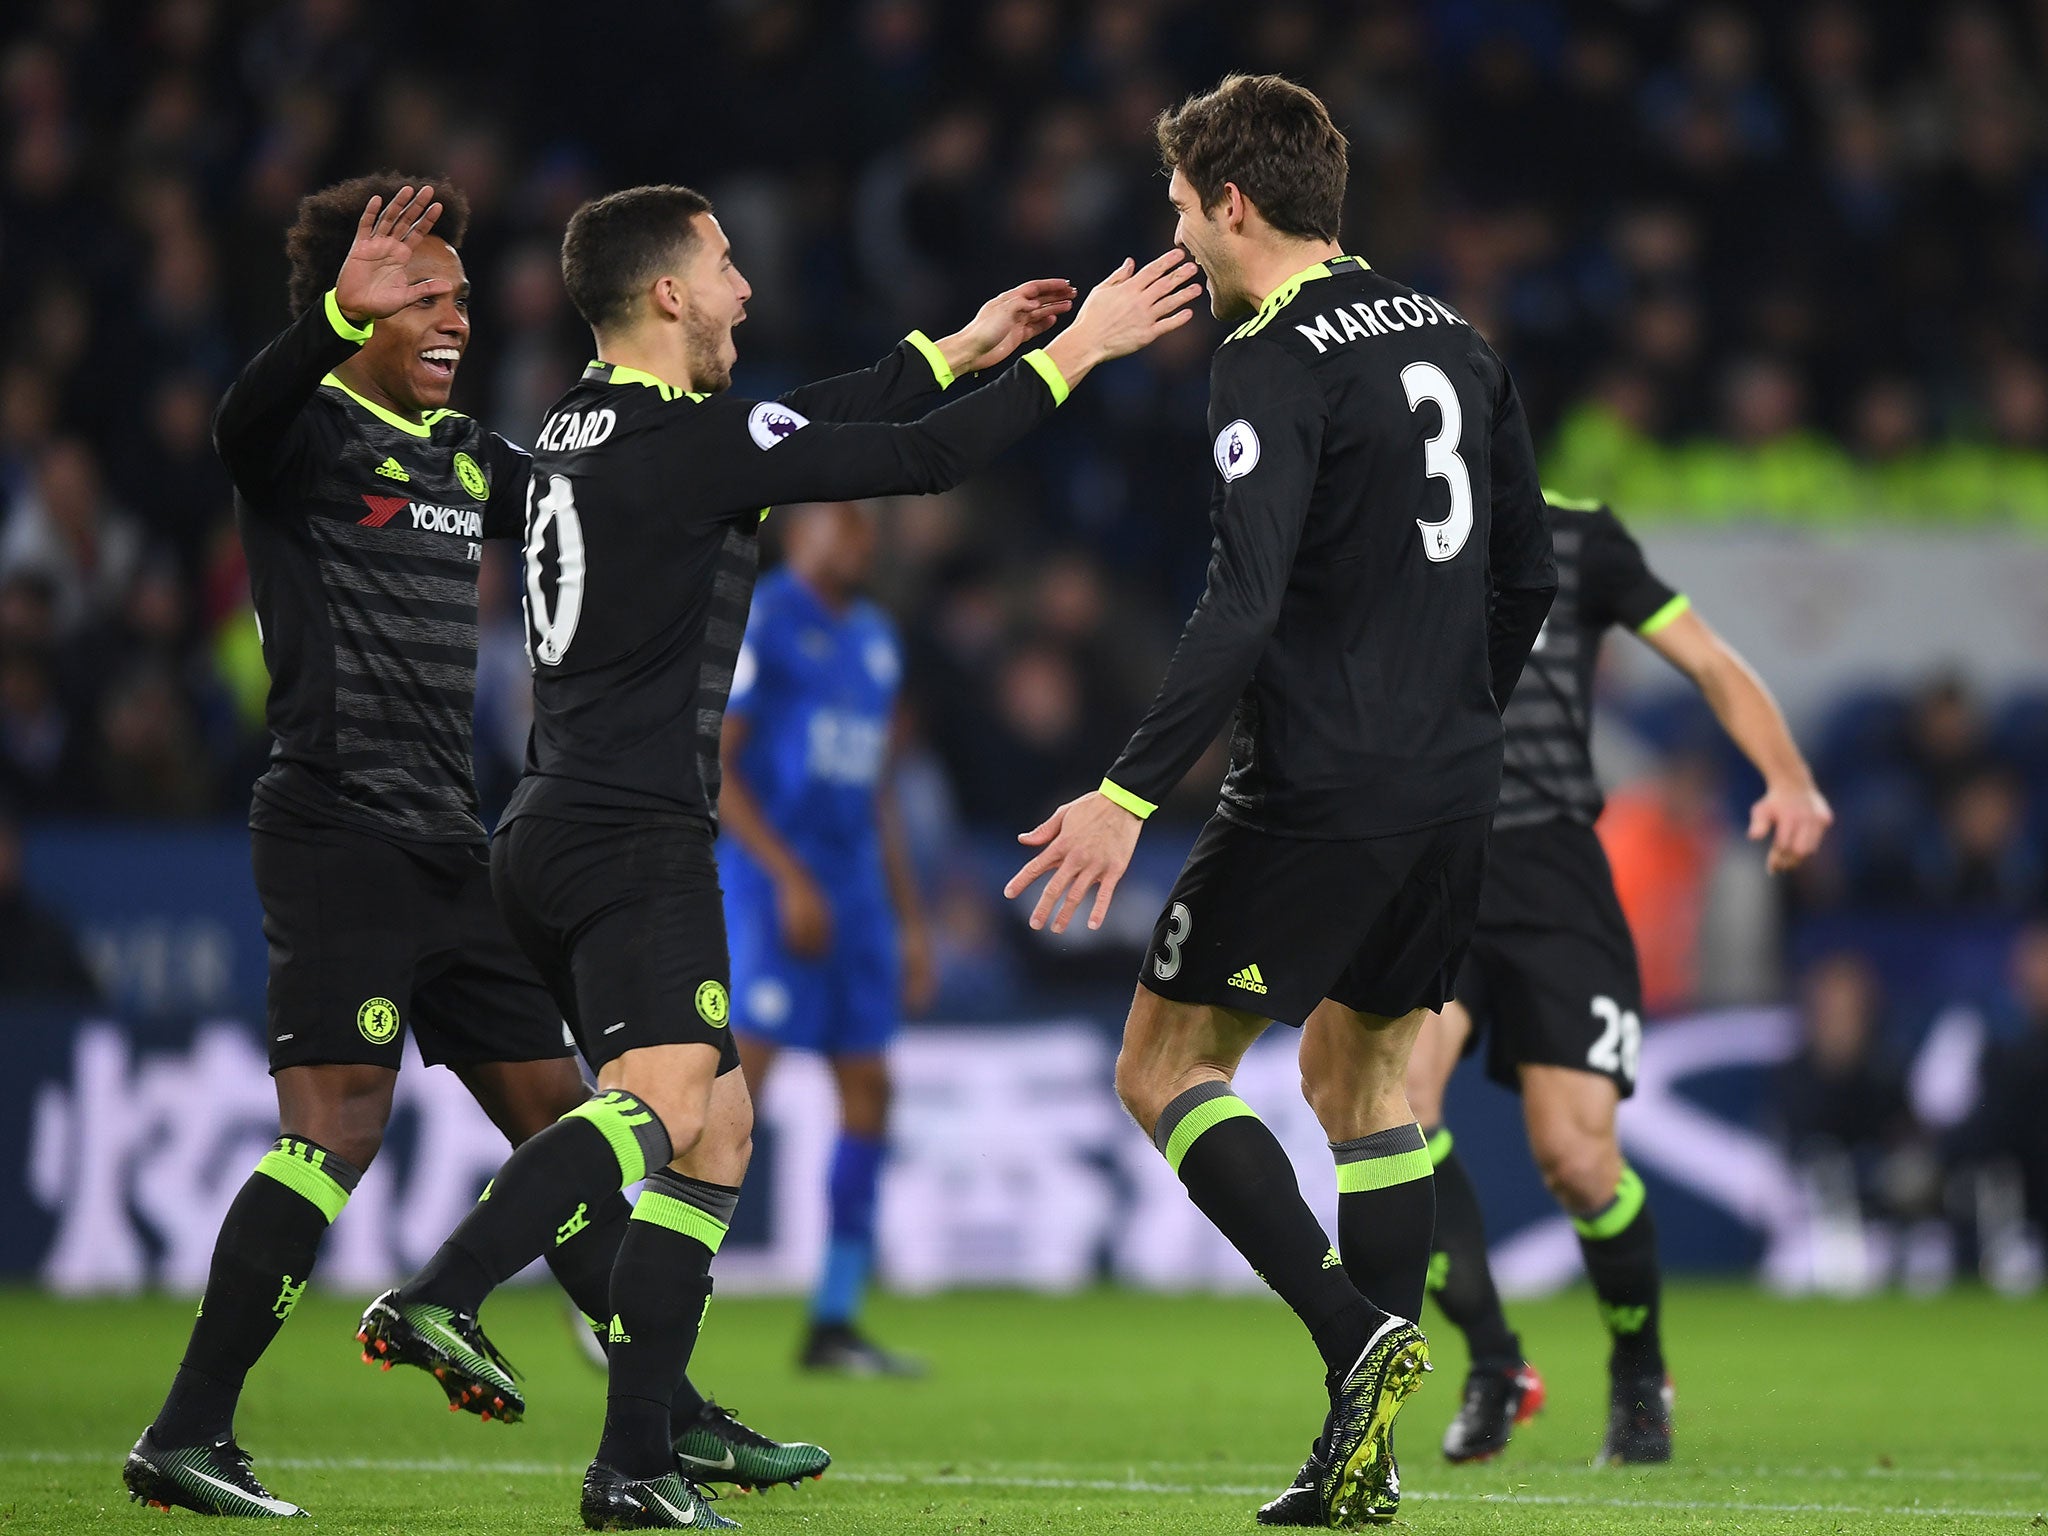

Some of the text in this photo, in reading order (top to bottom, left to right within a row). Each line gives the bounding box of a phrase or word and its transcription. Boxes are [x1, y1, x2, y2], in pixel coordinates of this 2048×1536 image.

[1295, 293, 1439, 354] MARCOS
[535, 408, 616, 451] AZARD
[1400, 361, 1474, 562] 3
[409, 502, 484, 538] YOKOHA
[1153, 901, 1193, 981] 3
[1227, 975, 1268, 995] adidas
